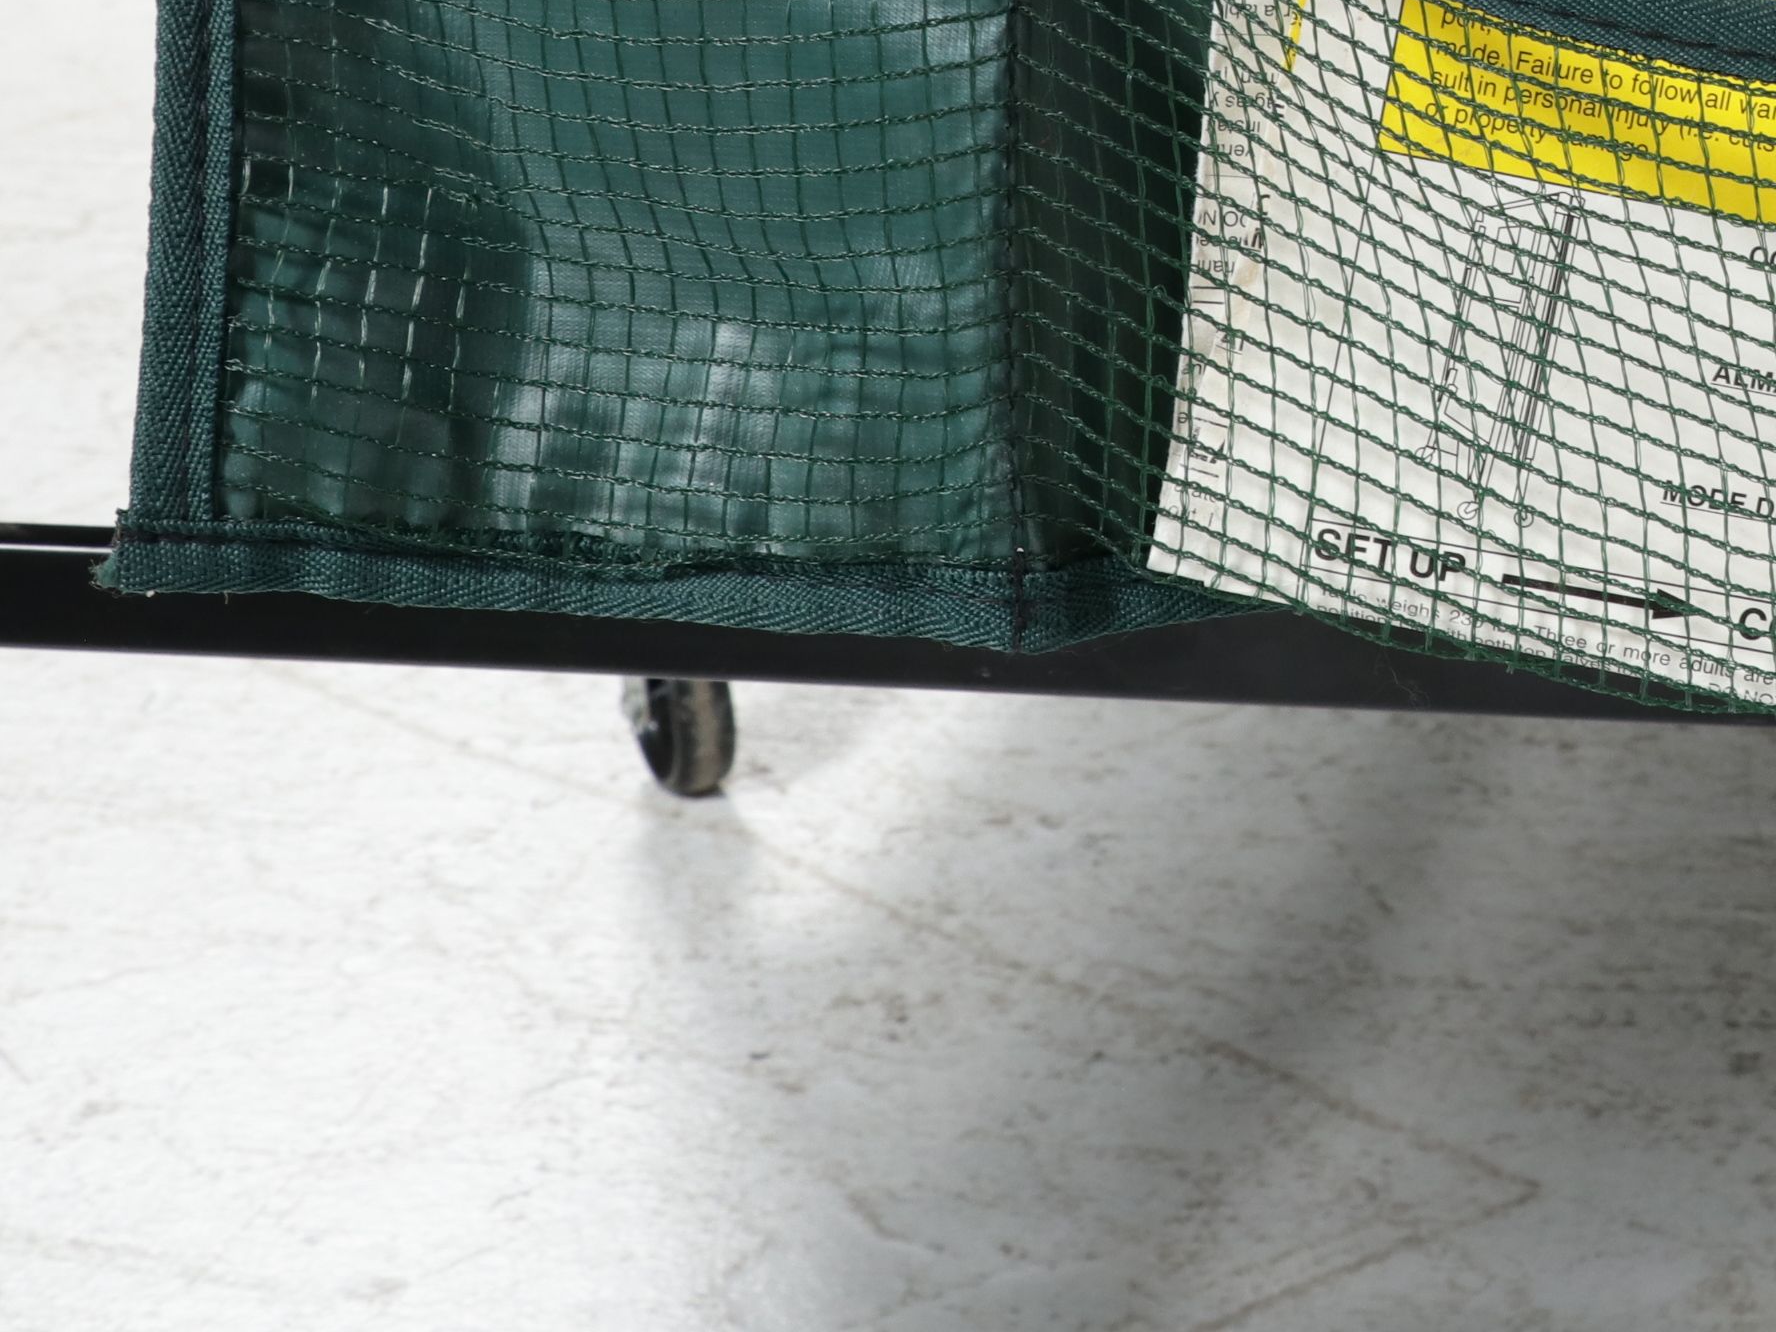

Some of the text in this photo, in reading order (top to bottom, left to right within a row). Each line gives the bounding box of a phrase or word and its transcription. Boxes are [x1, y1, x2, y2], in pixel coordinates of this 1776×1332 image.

[1476, 75, 1497, 98] in
[1503, 85, 1604, 120] personal
[1515, 50, 1594, 85] Failure
[1602, 68, 1624, 90] to
[1630, 73, 1699, 105] follow
[1704, 90, 1732, 112] all
[1662, 479, 1747, 510] MODE
[1313, 527, 1467, 582] SET UP
[1533, 625, 1588, 649] Three
[1595, 641, 1616, 655] or
[1622, 647, 1671, 666] more
[1678, 655, 1735, 678] adults
[1743, 669, 1775, 686] are
